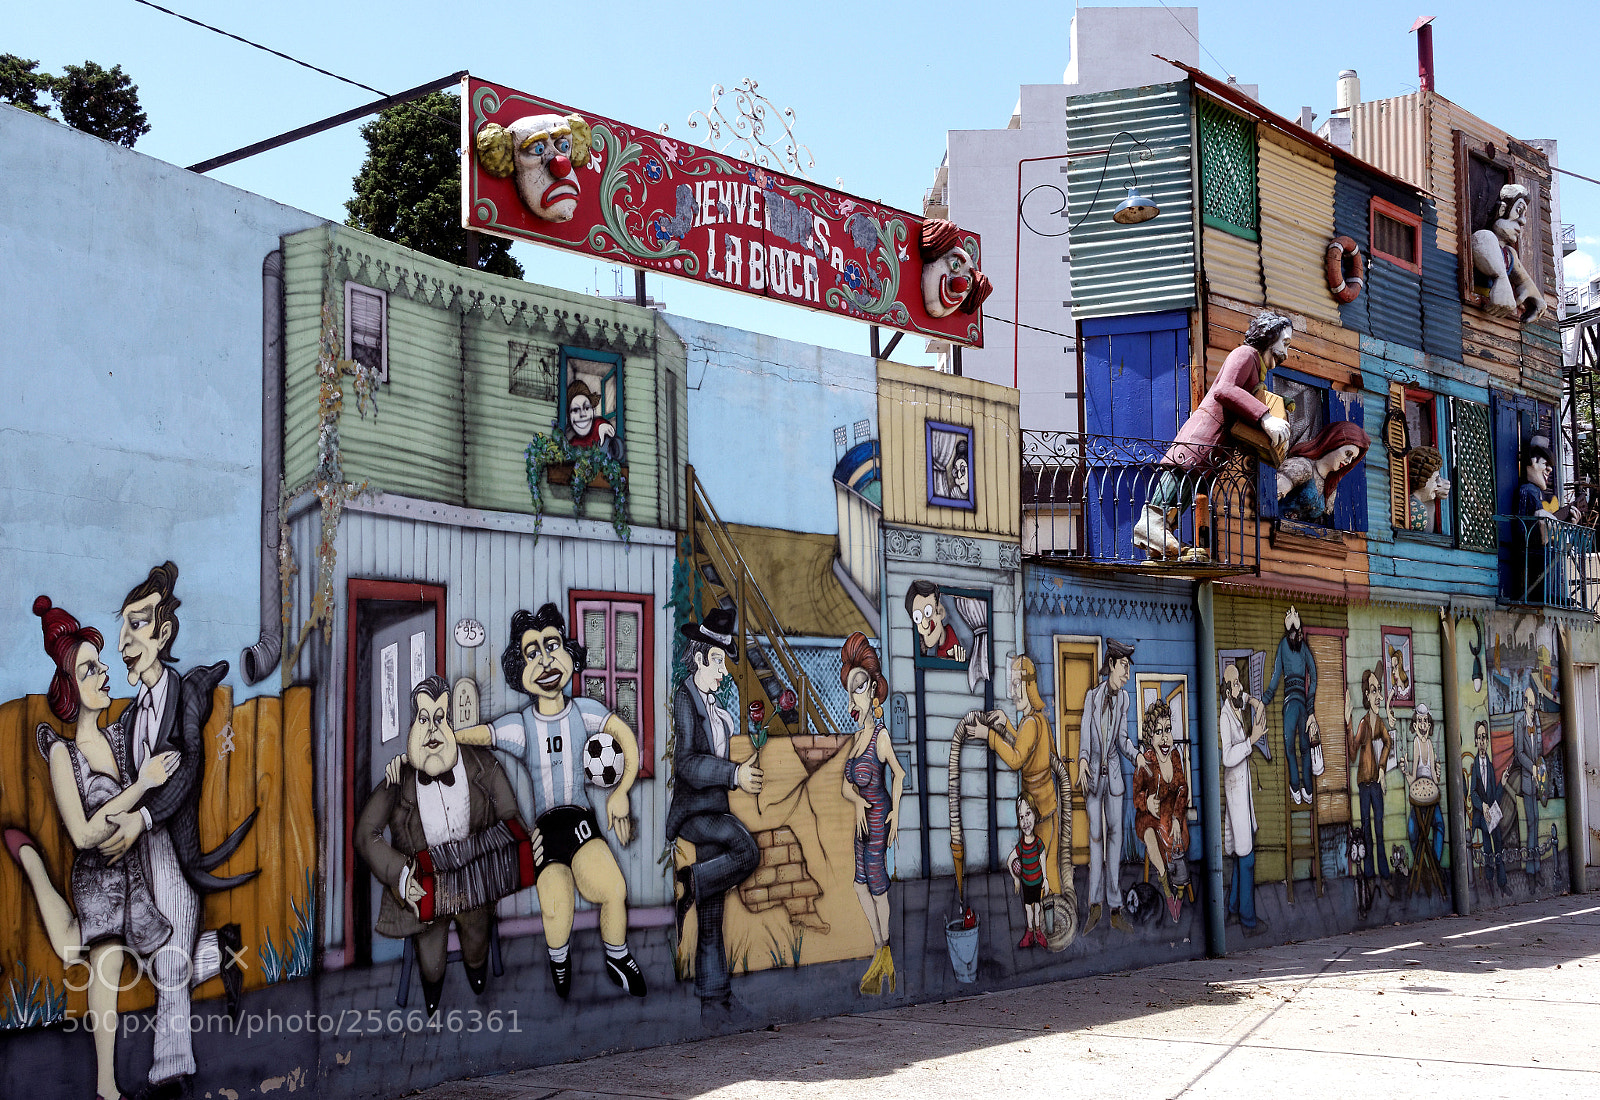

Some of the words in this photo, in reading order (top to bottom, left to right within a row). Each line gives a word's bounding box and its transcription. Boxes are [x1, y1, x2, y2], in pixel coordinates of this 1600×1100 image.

[706, 228, 742, 286] LA
[748, 240, 820, 303] BOCA
[830, 246, 845, 273] A
[463, 626, 477, 641] 95
[459, 695, 472, 707] LA
[546, 735, 563, 754] 10
[574, 820, 592, 844] 10
